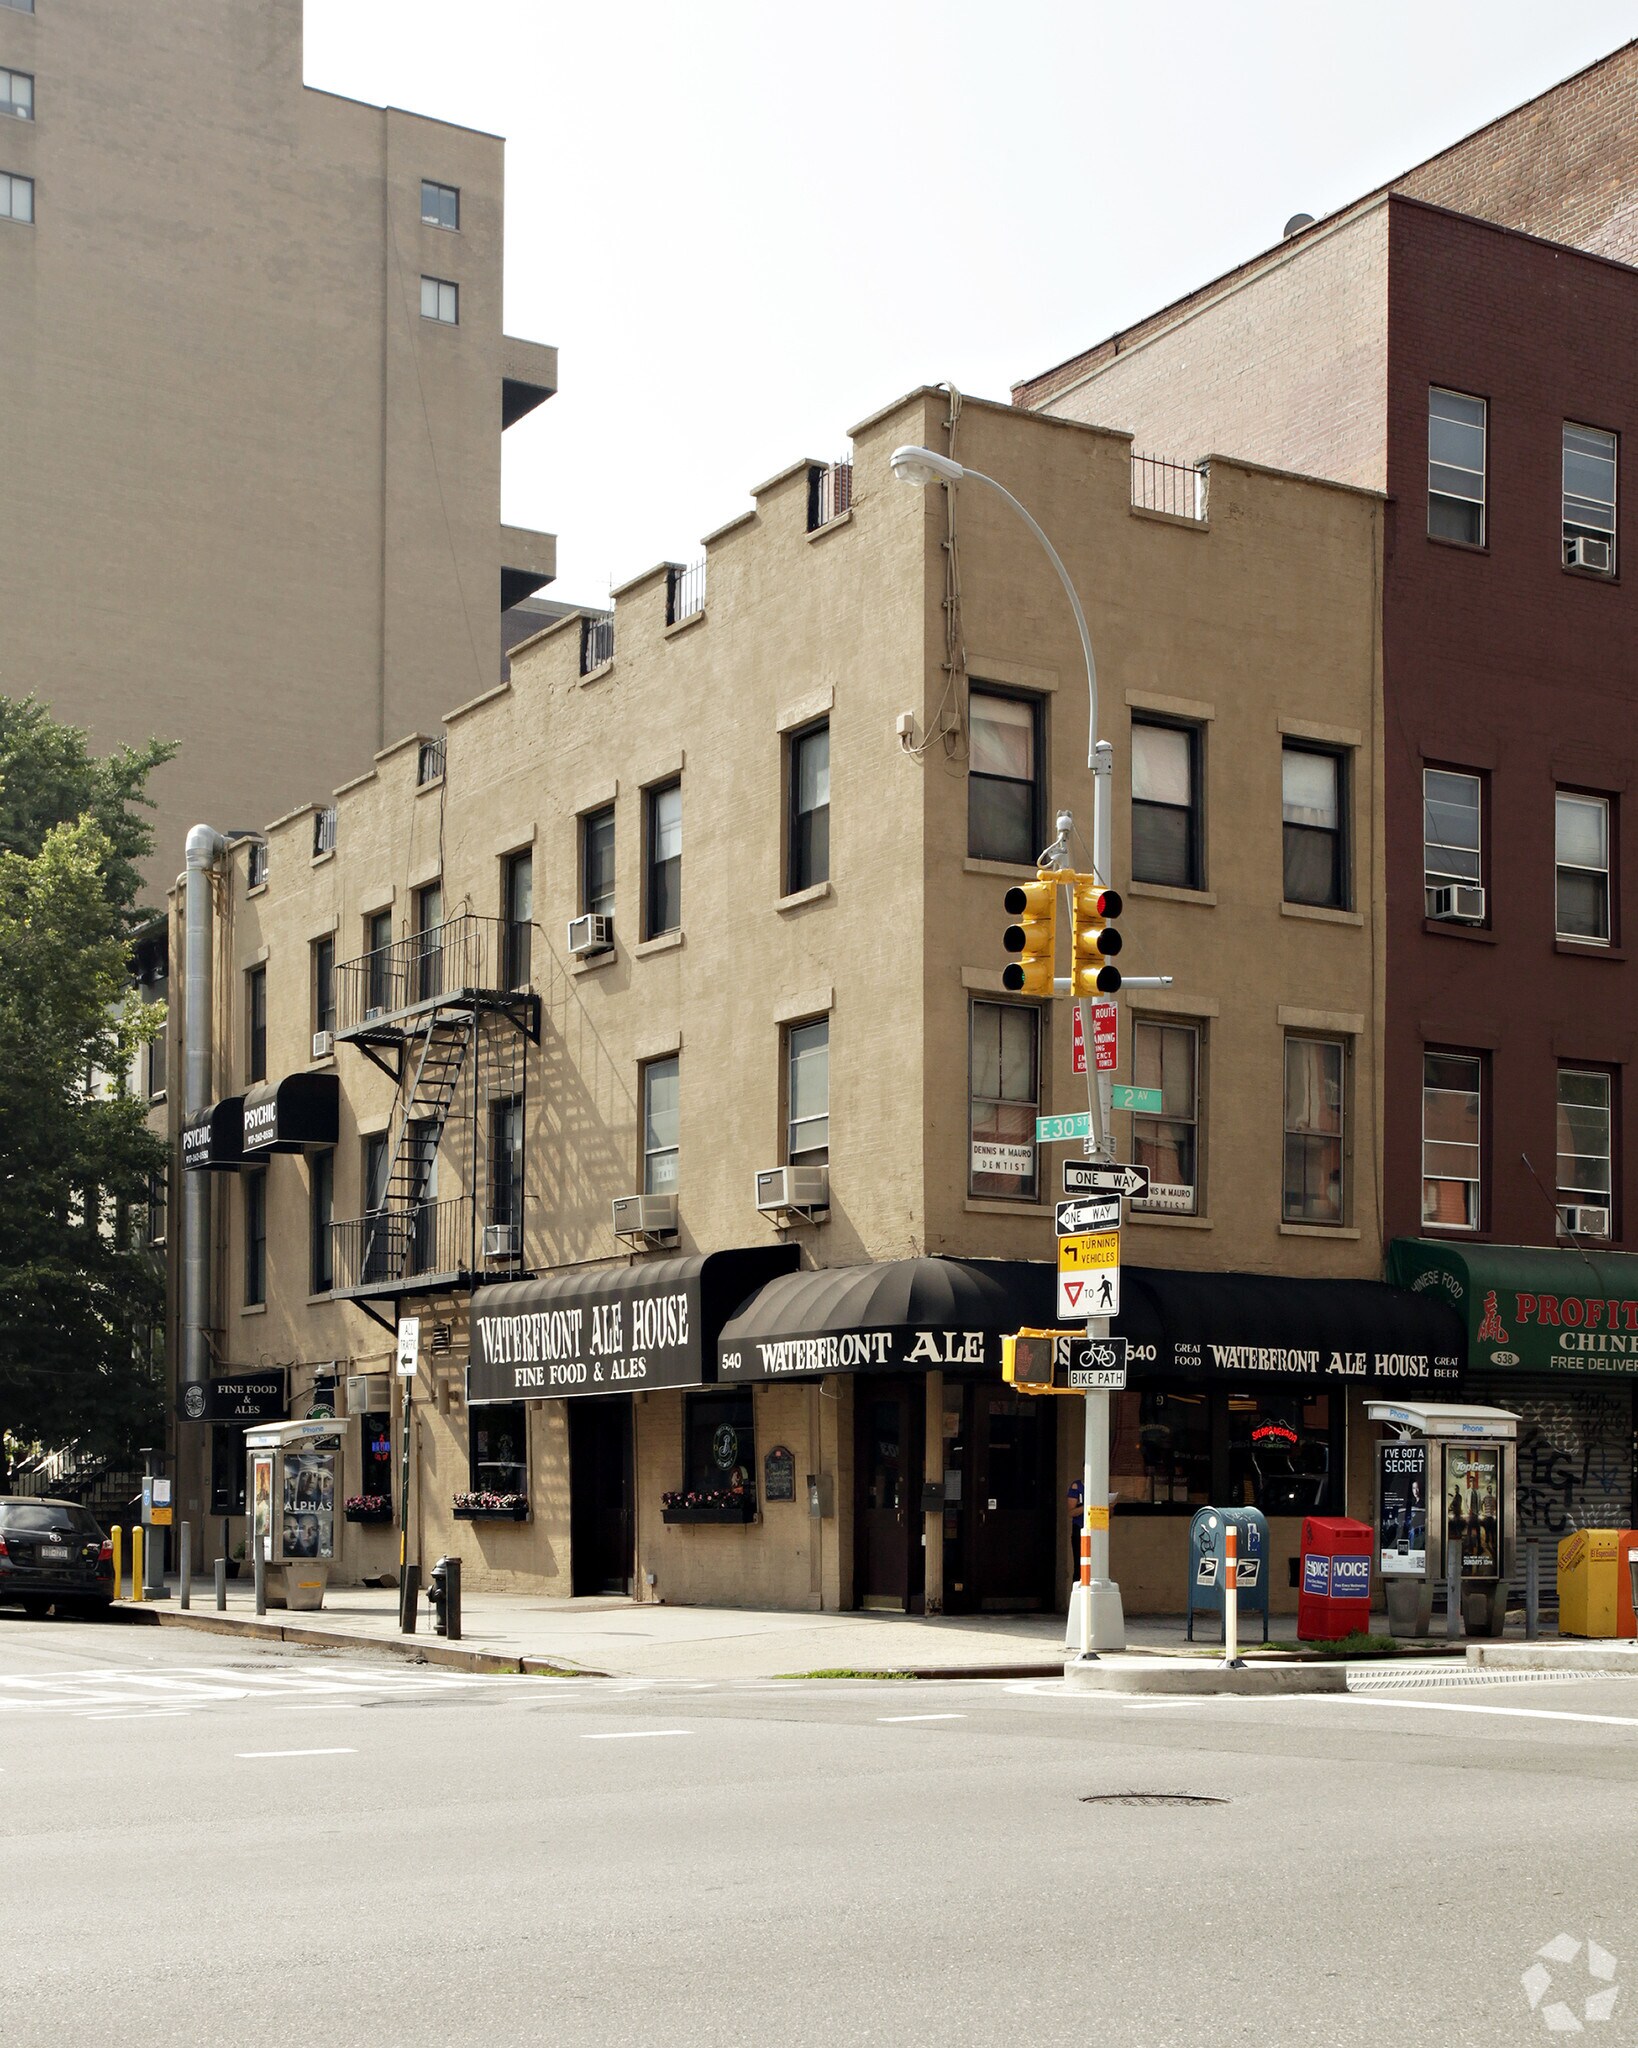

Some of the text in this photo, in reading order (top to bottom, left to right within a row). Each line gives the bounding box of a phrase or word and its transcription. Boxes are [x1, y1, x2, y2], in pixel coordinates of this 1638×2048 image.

[1095, 1008, 1115, 1018] ROUTE
[1124, 1090, 1149, 1107] 2 AV
[244, 1102, 276, 1130] PSYCHIC
[1040, 1116, 1088, 1138] E 30 ST
[183, 1125, 211, 1150] PSYCHIC
[974, 1146, 997, 1156] DENNIS
[1008, 1148, 1032, 1158] MAURO
[982, 1160, 1025, 1171] DENTIST
[1076, 1172, 1137, 1188] ONE WAY
[1168, 1189, 1190, 1198] MAURO
[1142, 1200, 1186, 1210] DENTIST
[1064, 1206, 1111, 1224] ONE WAY
[1081, 1238, 1116, 1250] TURNING
[1081, 1252, 1116, 1264] VEHICLES
[1441, 1272, 1464, 1299] FOOD
[1084, 1289, 1094, 1299] TO
[477, 1292, 690, 1364] WATERFRONT ALE HOUSE
[756, 1332, 892, 1373] WATERFRONT
[903, 1331, 984, 1364] ALE
[1127, 1345, 1157, 1361] 540
[1174, 1343, 1202, 1354] GREAT
[722, 1352, 742, 1370] 540
[1174, 1356, 1202, 1366] FOOD
[1207, 1344, 1430, 1378] WATERFRONT ALE HOUSE
[1434, 1357, 1458, 1366] GREAT
[1496, 1353, 1513, 1365] 538
[1550, 1356, 1584, 1370] FREE
[515, 1356, 647, 1387] FINE FOOD & ALES
[1434, 1369, 1458, 1378] BEER
[1072, 1372, 1123, 1384] BIKE PATH
[217, 1385, 278, 1394] FINE FOOD
[244, 1396, 251, 1404] &
[234, 1405, 260, 1414] ALES
[1389, 1408, 1410, 1420] Phone
[302, 1426, 324, 1434] Phone
[1462, 1424, 1484, 1433] Phone
[1384, 1448, 1424, 1458] I'VE GOT A
[1384, 1460, 1424, 1473] SECRET
[284, 1500, 332, 1511] ALPHAS
[1336, 1562, 1368, 1577] VOICE
